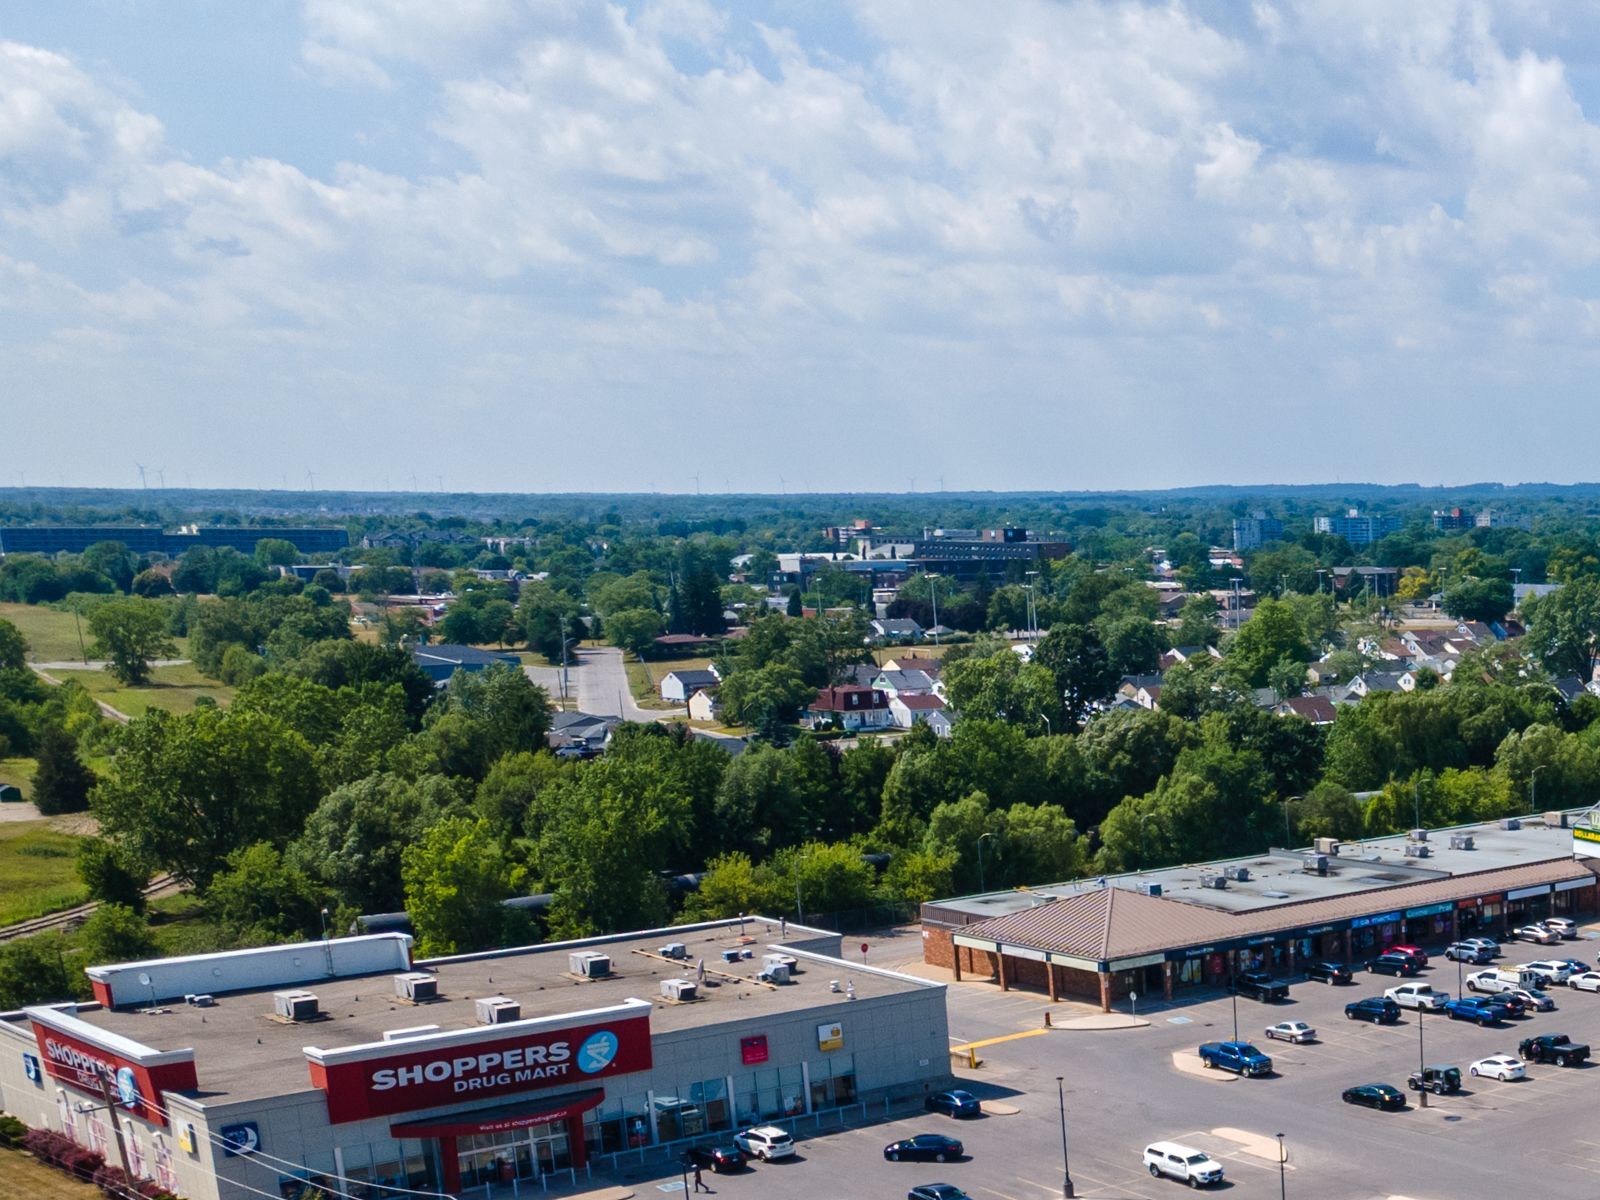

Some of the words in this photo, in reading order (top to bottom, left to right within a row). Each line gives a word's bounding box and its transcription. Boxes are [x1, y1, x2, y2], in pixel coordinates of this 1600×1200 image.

[371, 1042, 570, 1091] SHOPPERS
[454, 1072, 512, 1093] DRUG
[515, 1063, 570, 1082] MART
